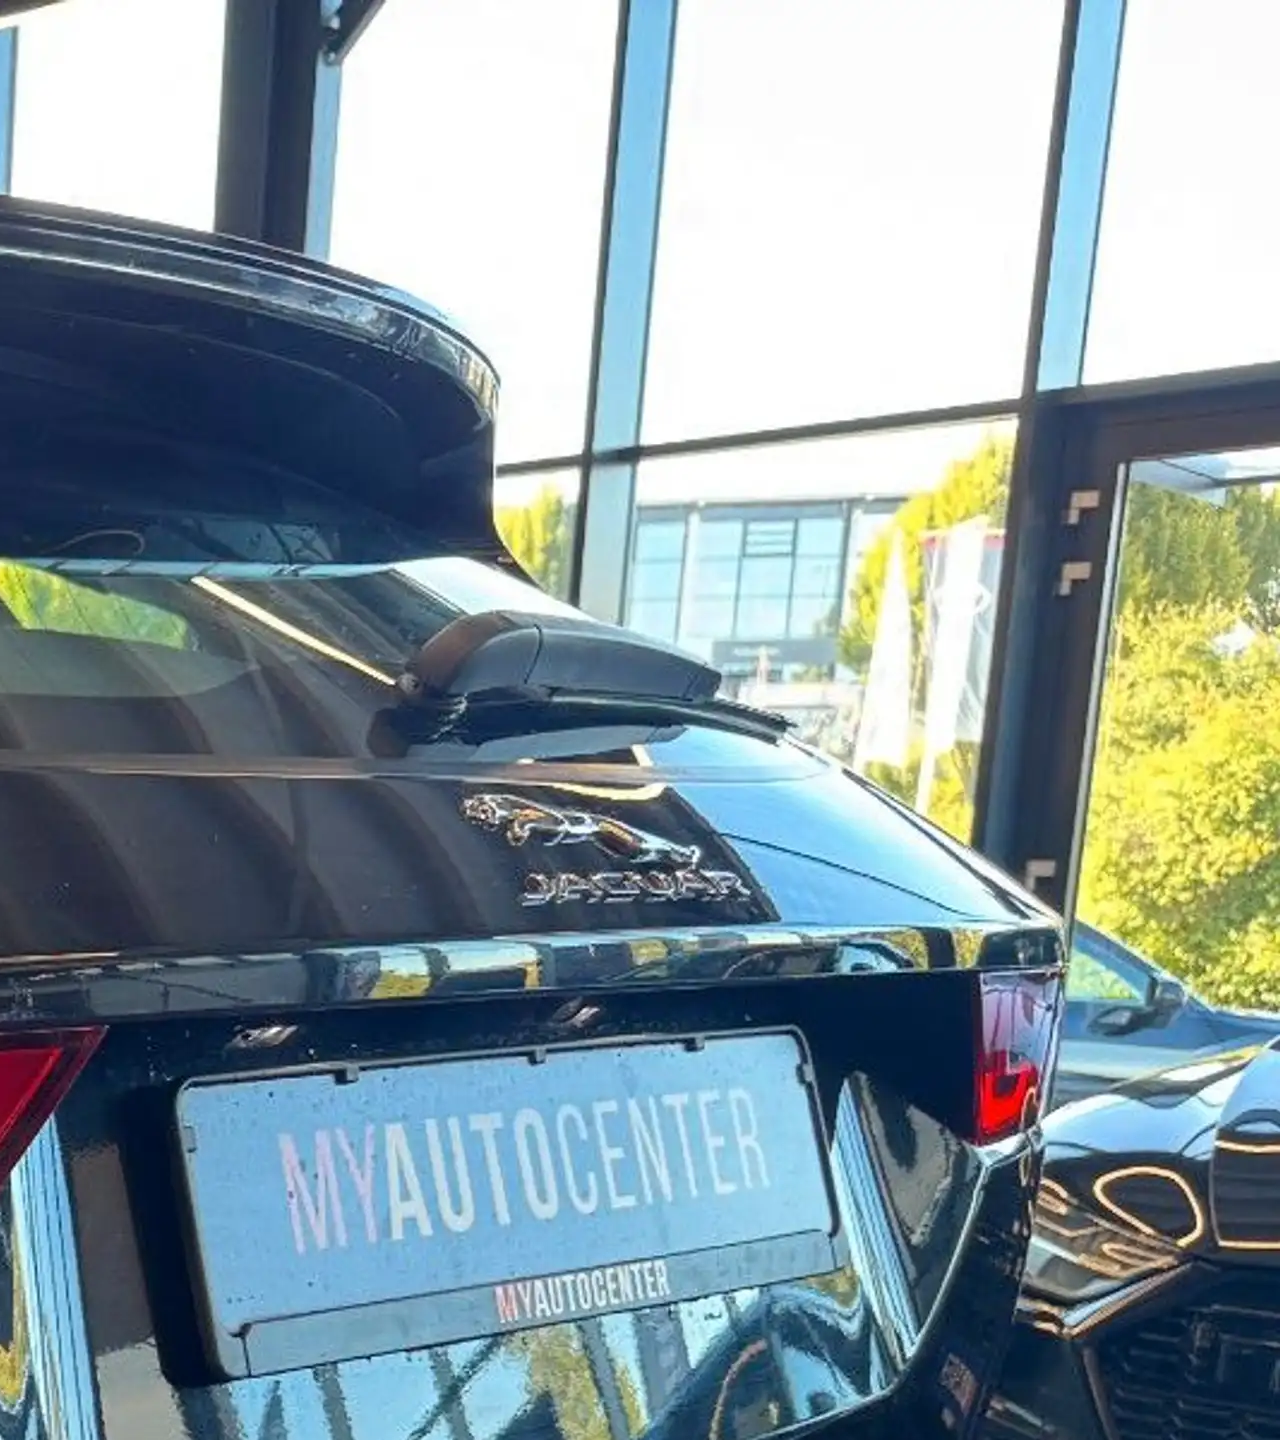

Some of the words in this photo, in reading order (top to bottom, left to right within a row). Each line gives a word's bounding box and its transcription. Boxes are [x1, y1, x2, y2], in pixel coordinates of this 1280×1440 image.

[521, 869, 751, 906] JAGUAR
[278, 1089, 771, 1255] MYAUTOCENTER
[495, 1259, 671, 1324] MYAUTOCENTER
